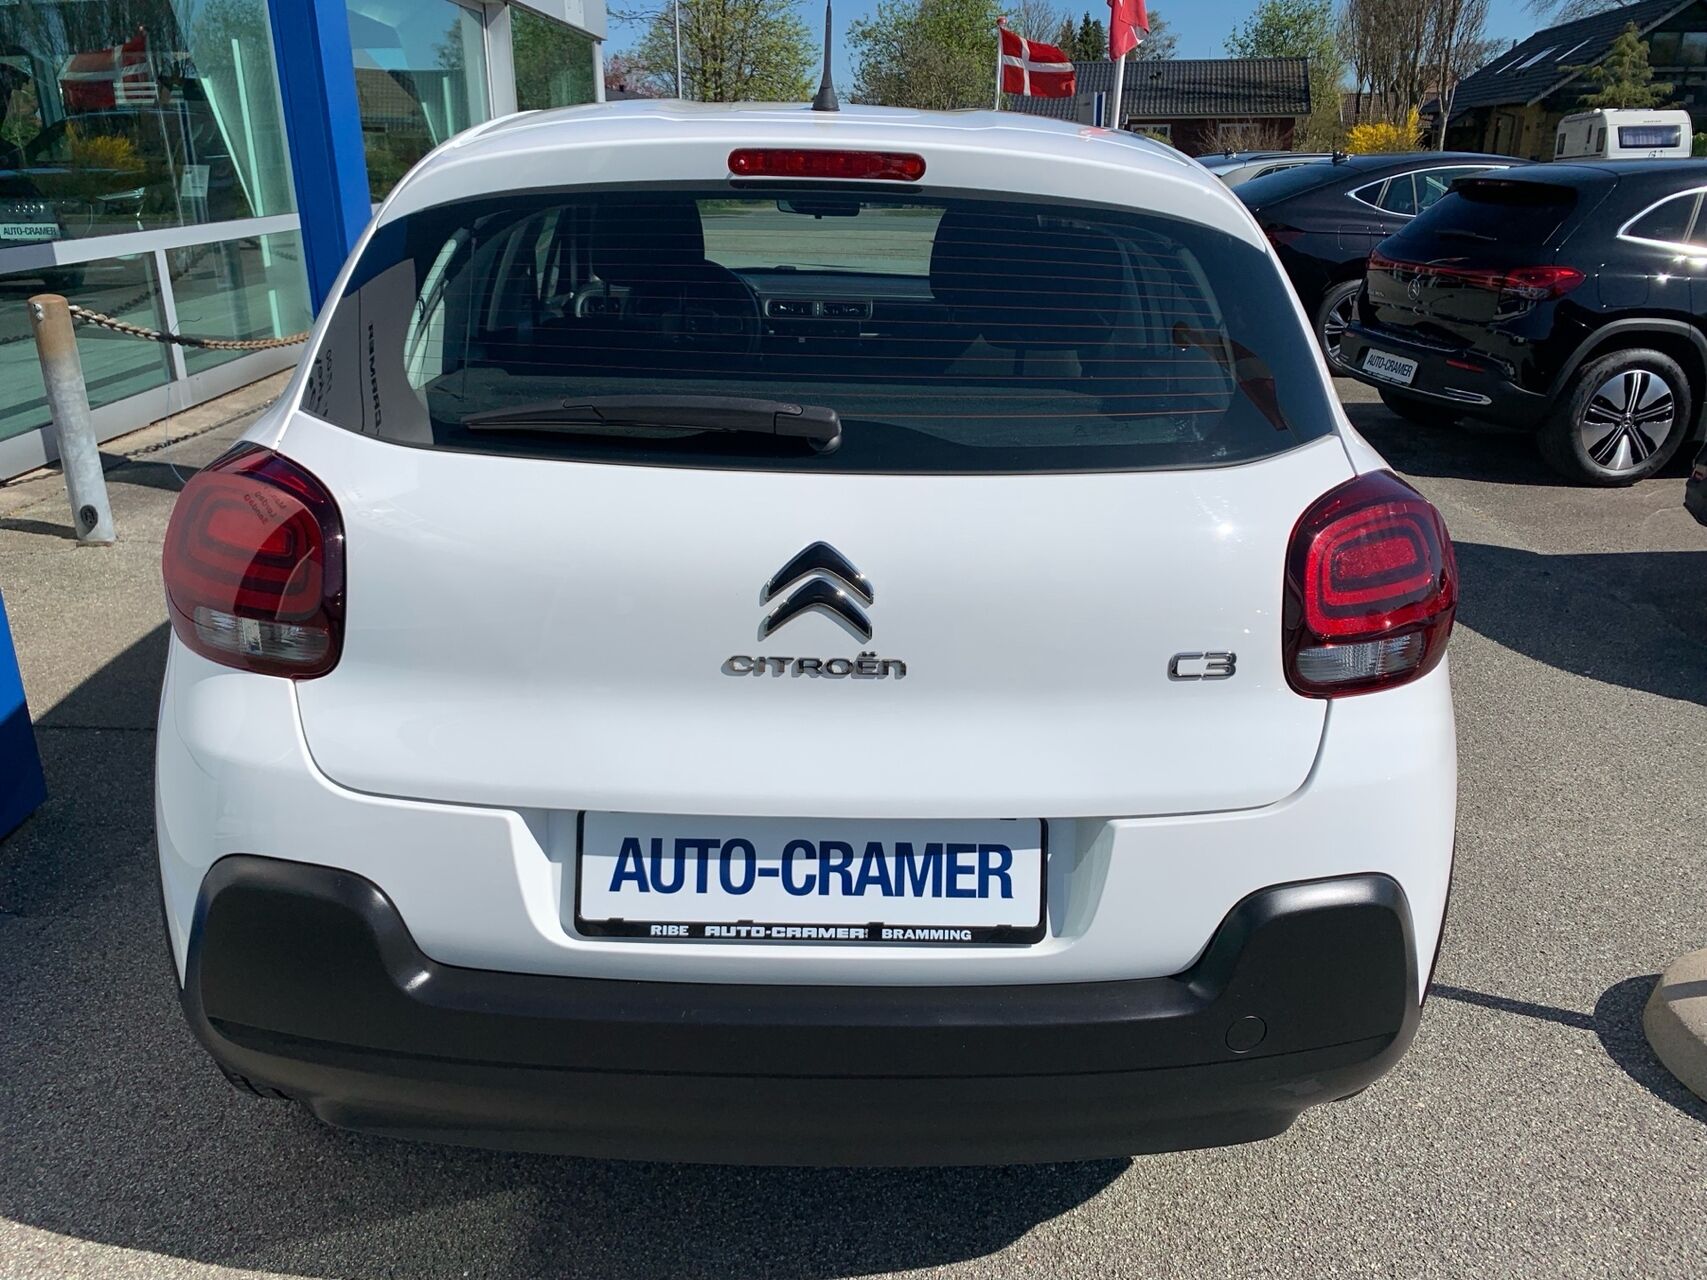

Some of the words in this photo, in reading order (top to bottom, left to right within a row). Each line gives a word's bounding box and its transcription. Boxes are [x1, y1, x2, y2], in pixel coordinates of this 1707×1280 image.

[3, 226, 57, 236] AUTO-CRAMER
[1366, 353, 1414, 378] AUTO-CRAMER
[1168, 651, 1237, 680] C3
[608, 836, 1014, 899] AUTO-CRAMER
[649, 924, 690, 937] RIBE
[704, 925, 865, 940] AUTO-CRAMER
[881, 928, 972, 941] BRAMMING
